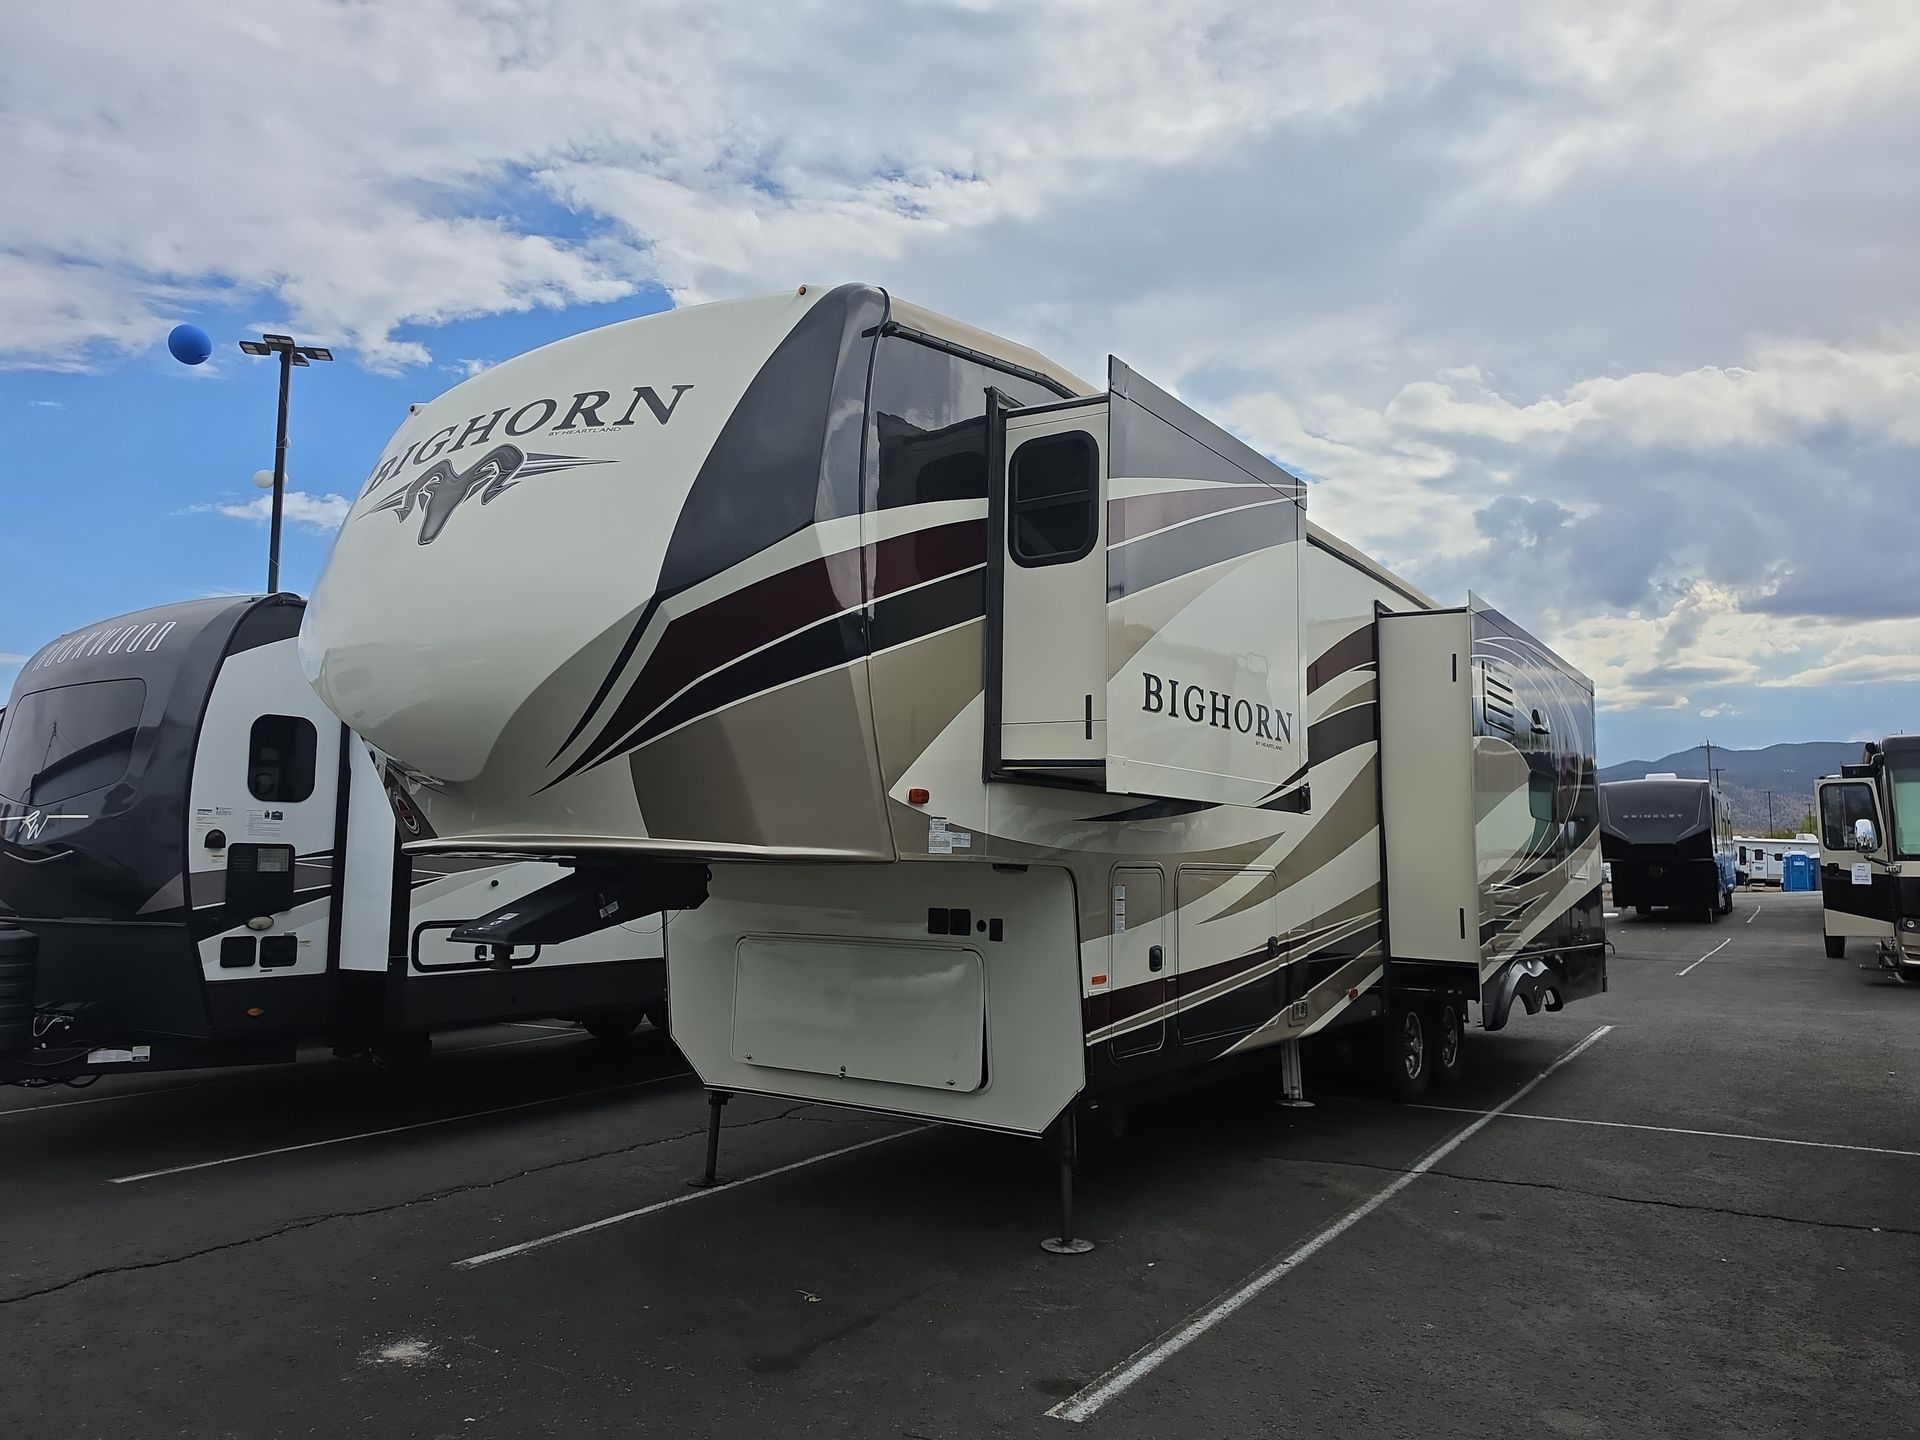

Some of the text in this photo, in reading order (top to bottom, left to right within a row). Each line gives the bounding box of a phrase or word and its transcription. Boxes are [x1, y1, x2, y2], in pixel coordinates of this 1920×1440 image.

[361, 385, 695, 500] BIGHORN
[562, 426, 622, 435] HEARTLAND
[31, 621, 177, 672] ROCKWOOD
[1142, 671, 1293, 744] BIGHORN
